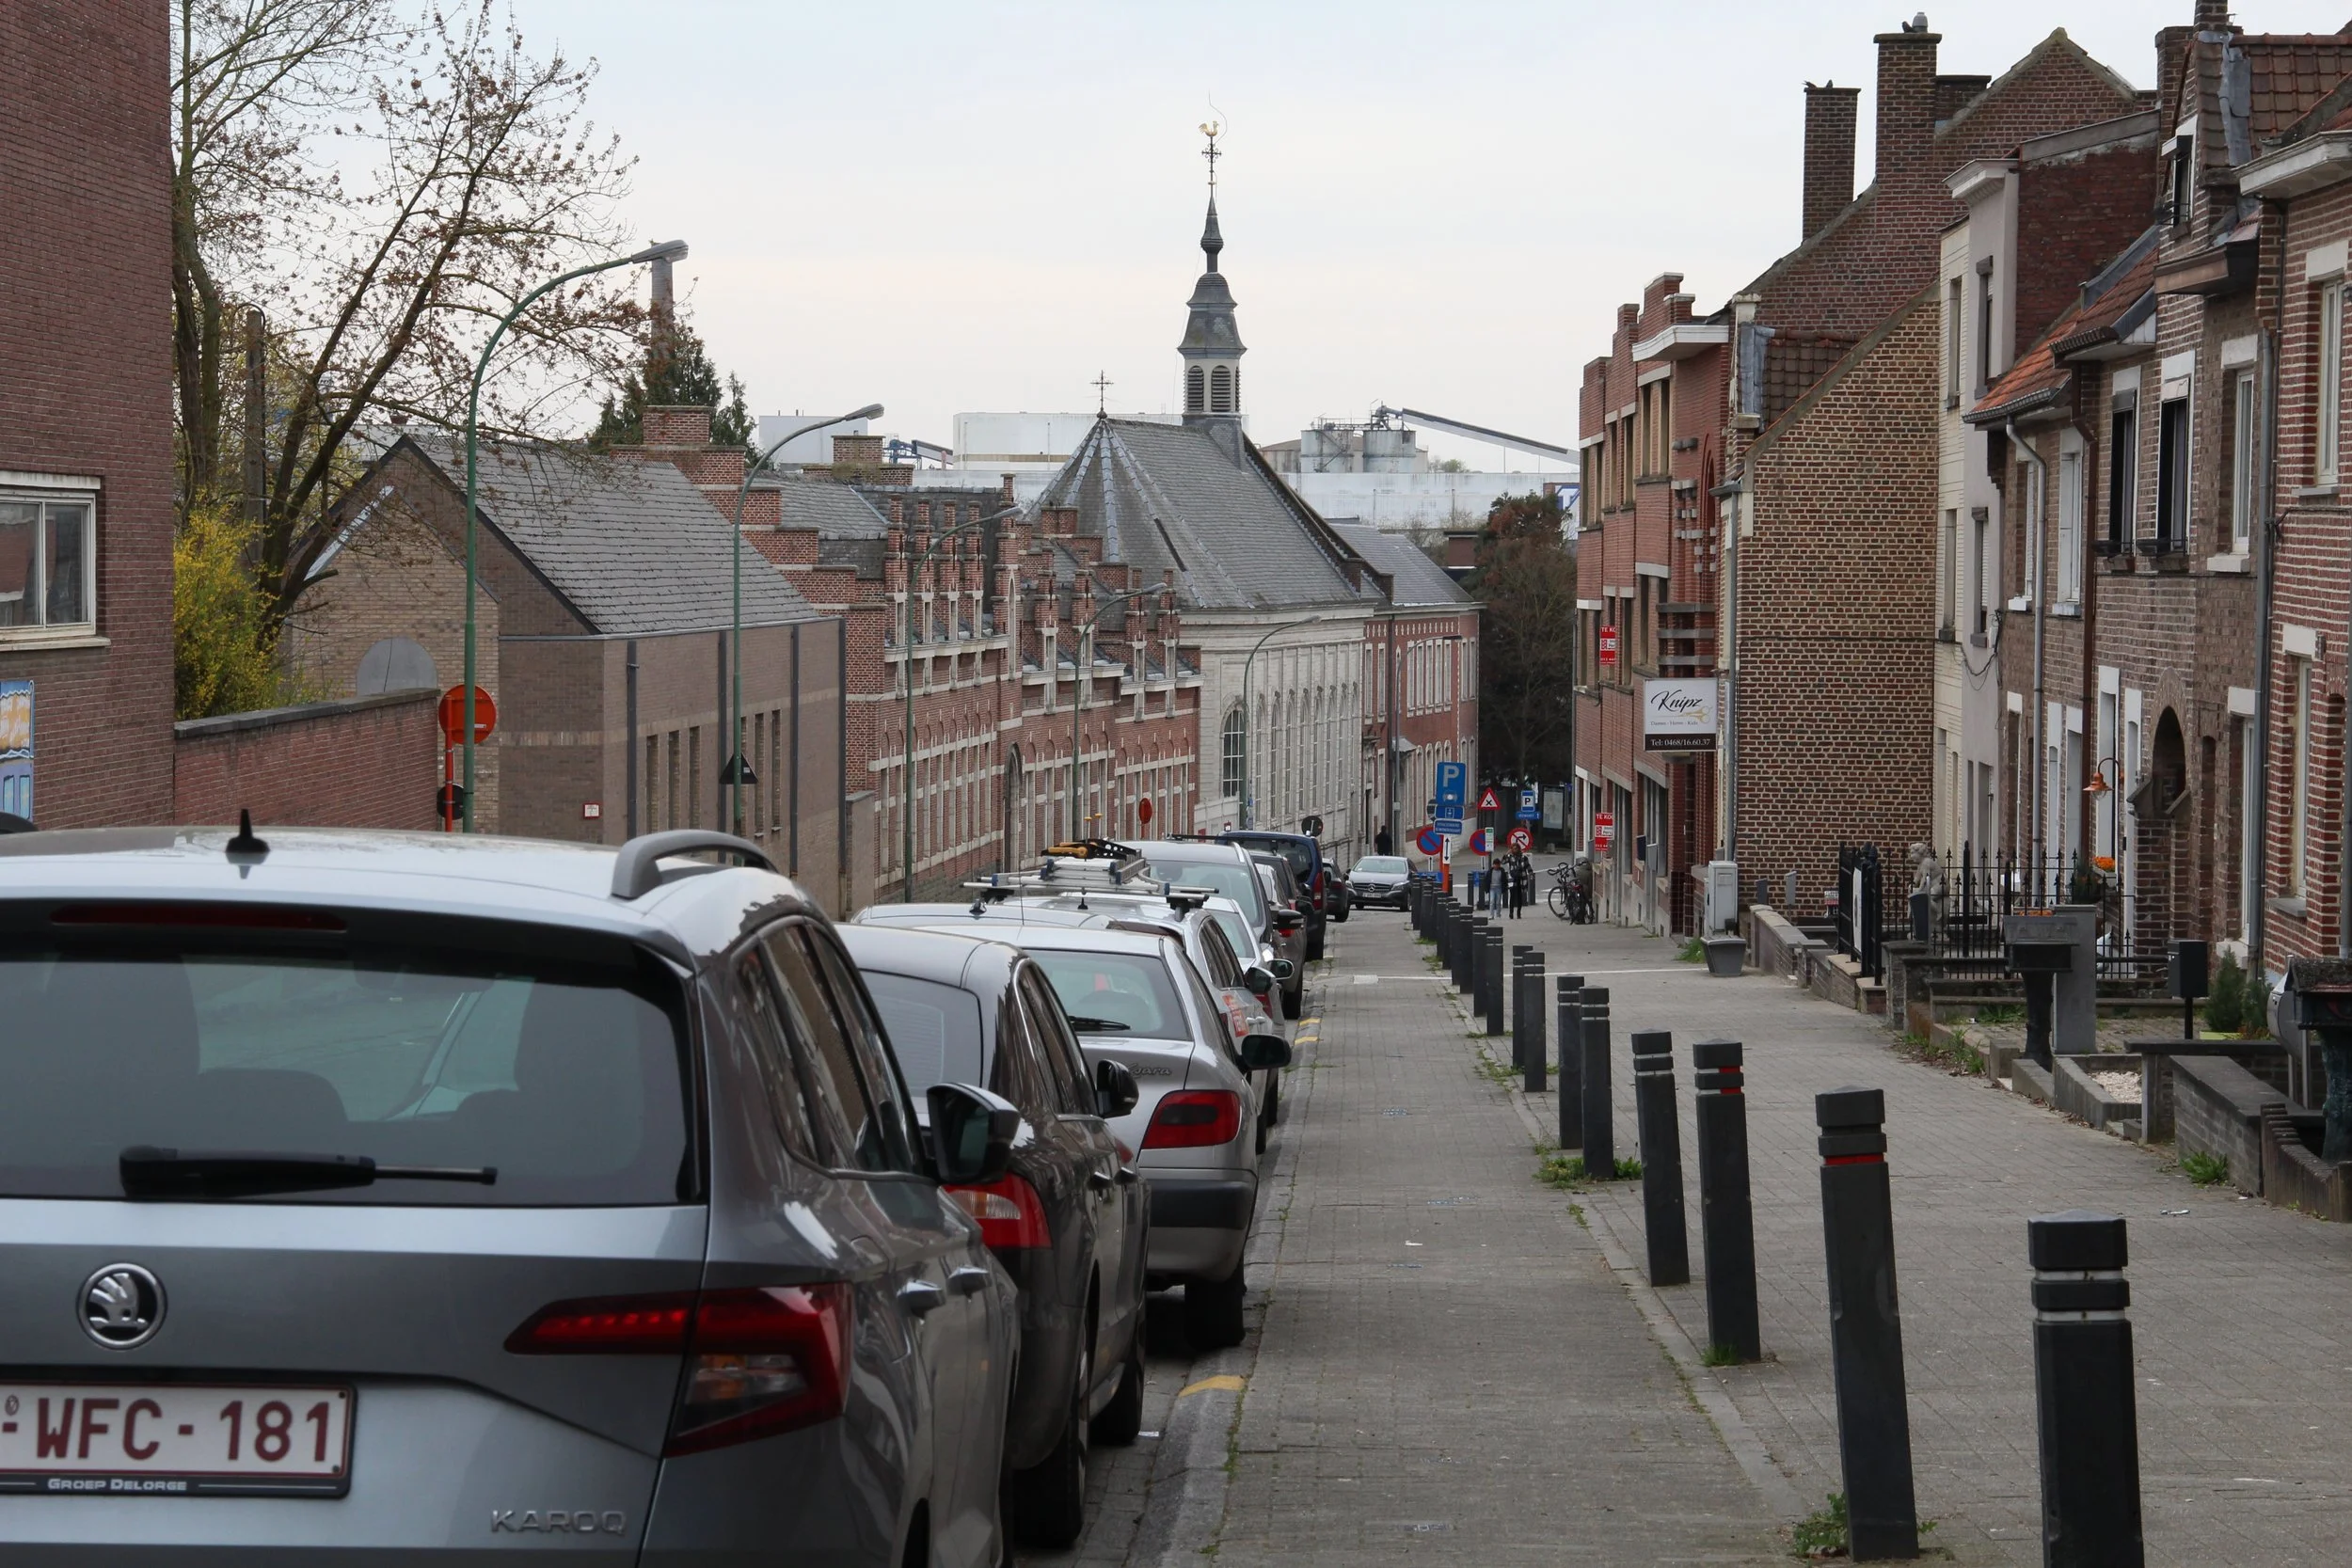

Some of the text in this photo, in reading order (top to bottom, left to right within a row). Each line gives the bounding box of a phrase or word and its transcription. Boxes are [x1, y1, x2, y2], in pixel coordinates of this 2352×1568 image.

[1650, 689, 1703, 713] Knipz
[1442, 764, 1460, 787] P
[1524, 797, 1531, 805] P
[491, 1509, 628, 1536] KAROQ
